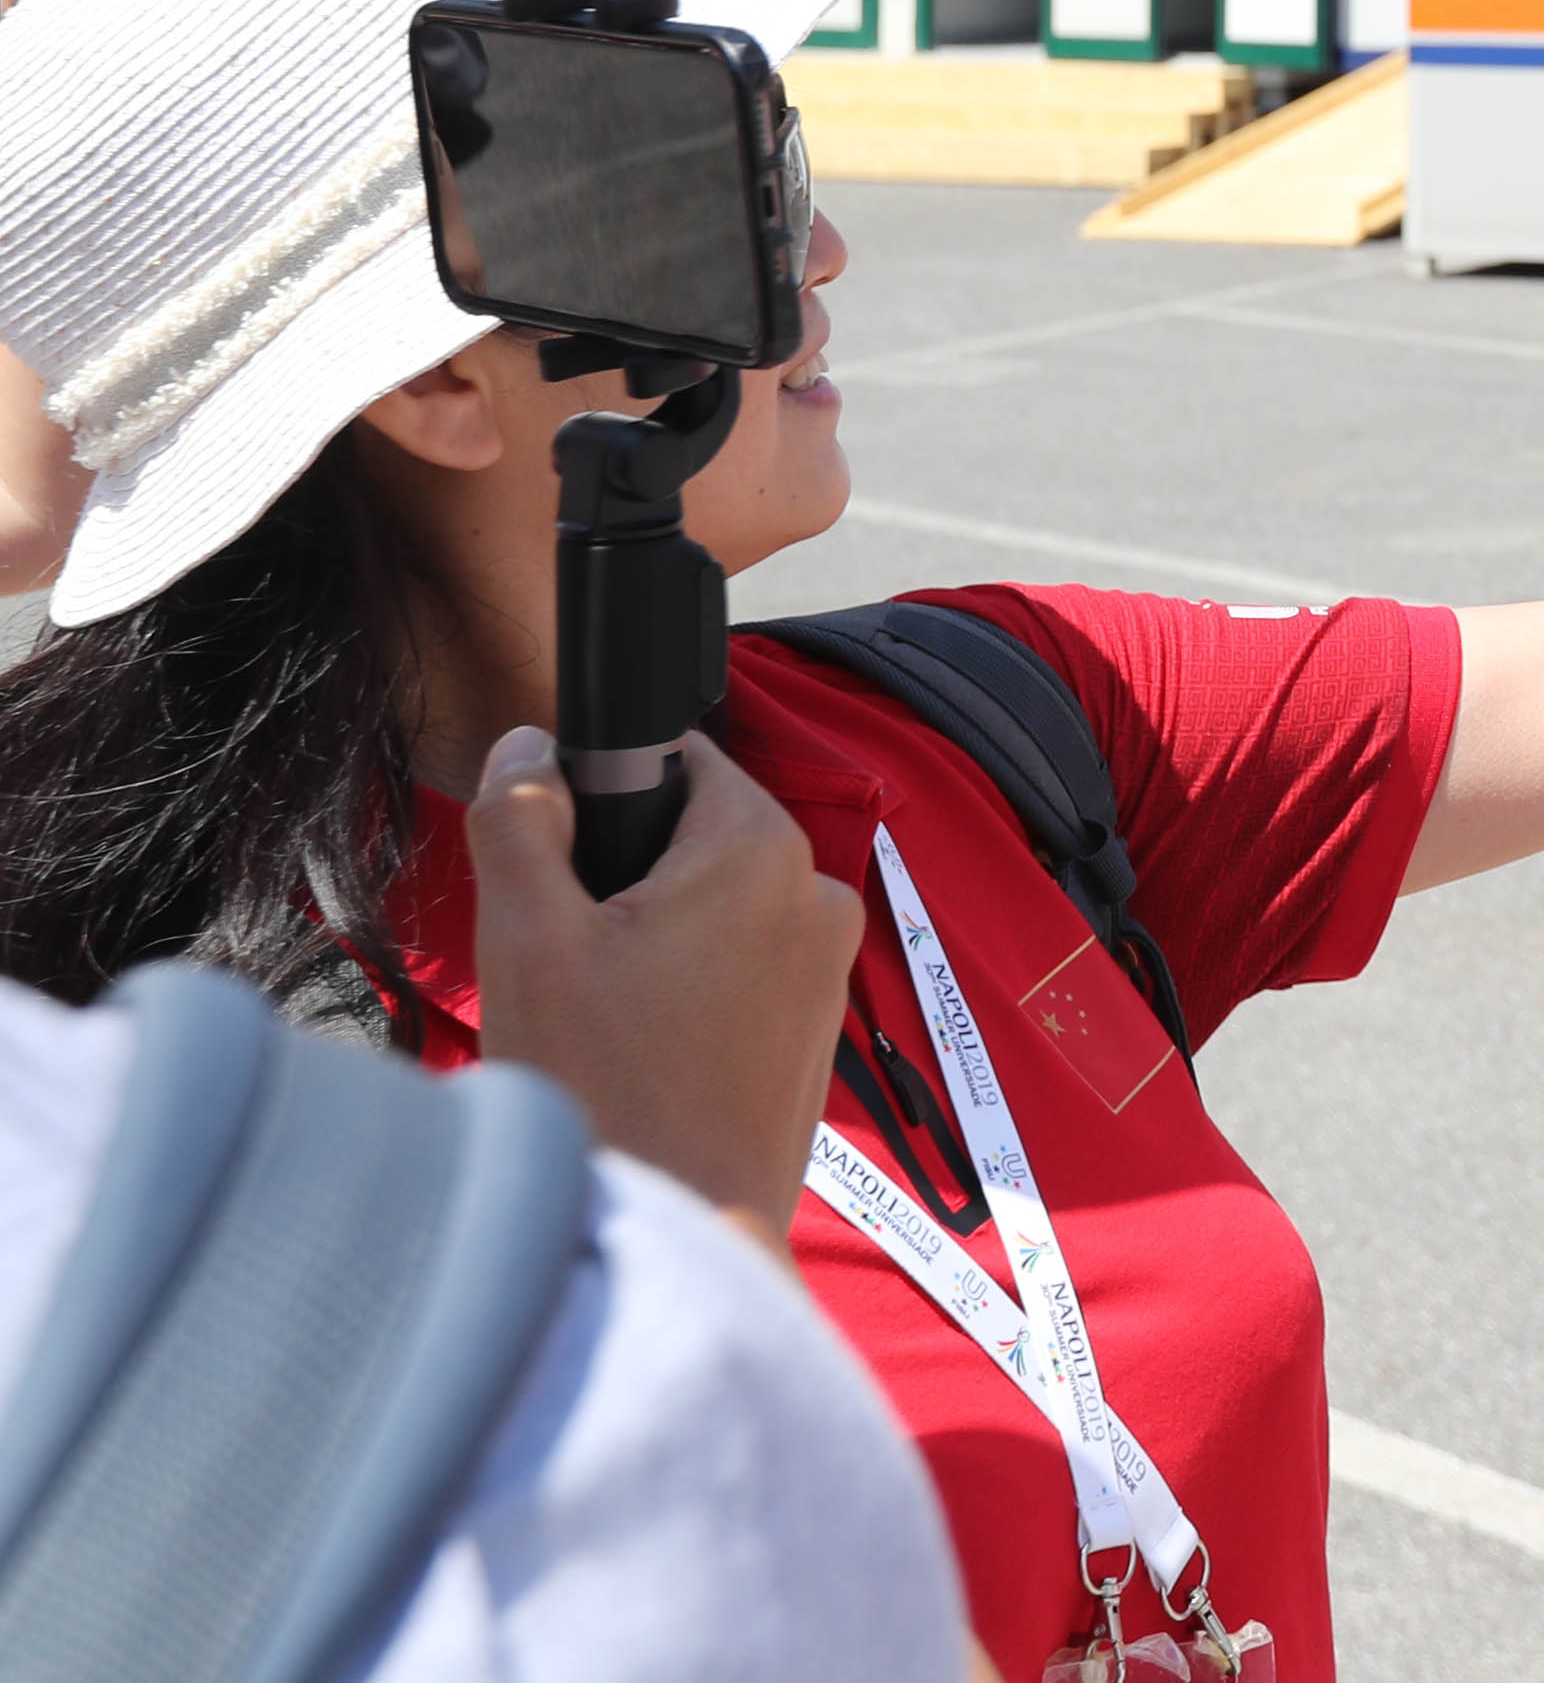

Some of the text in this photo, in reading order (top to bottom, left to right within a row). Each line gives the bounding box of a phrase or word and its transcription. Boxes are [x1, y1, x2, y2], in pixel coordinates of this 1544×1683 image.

[932, 963, 998, 1106] NAPOLI2019
[933, 985, 956, 1033] SUMMER
[952, 1035, 982, 1108] UNIVERSIADE
[814, 1136, 942, 1255] NAPOLI2019
[830, 1168, 874, 1207] SUMMER
[874, 1206, 935, 1265] UNIVERSIADE
[1049, 1309, 1070, 1361] SUMMER
[1066, 1364, 1092, 1444] UNIVERSIADE
[1051, 1282, 1106, 1442] NAPOLI2019
